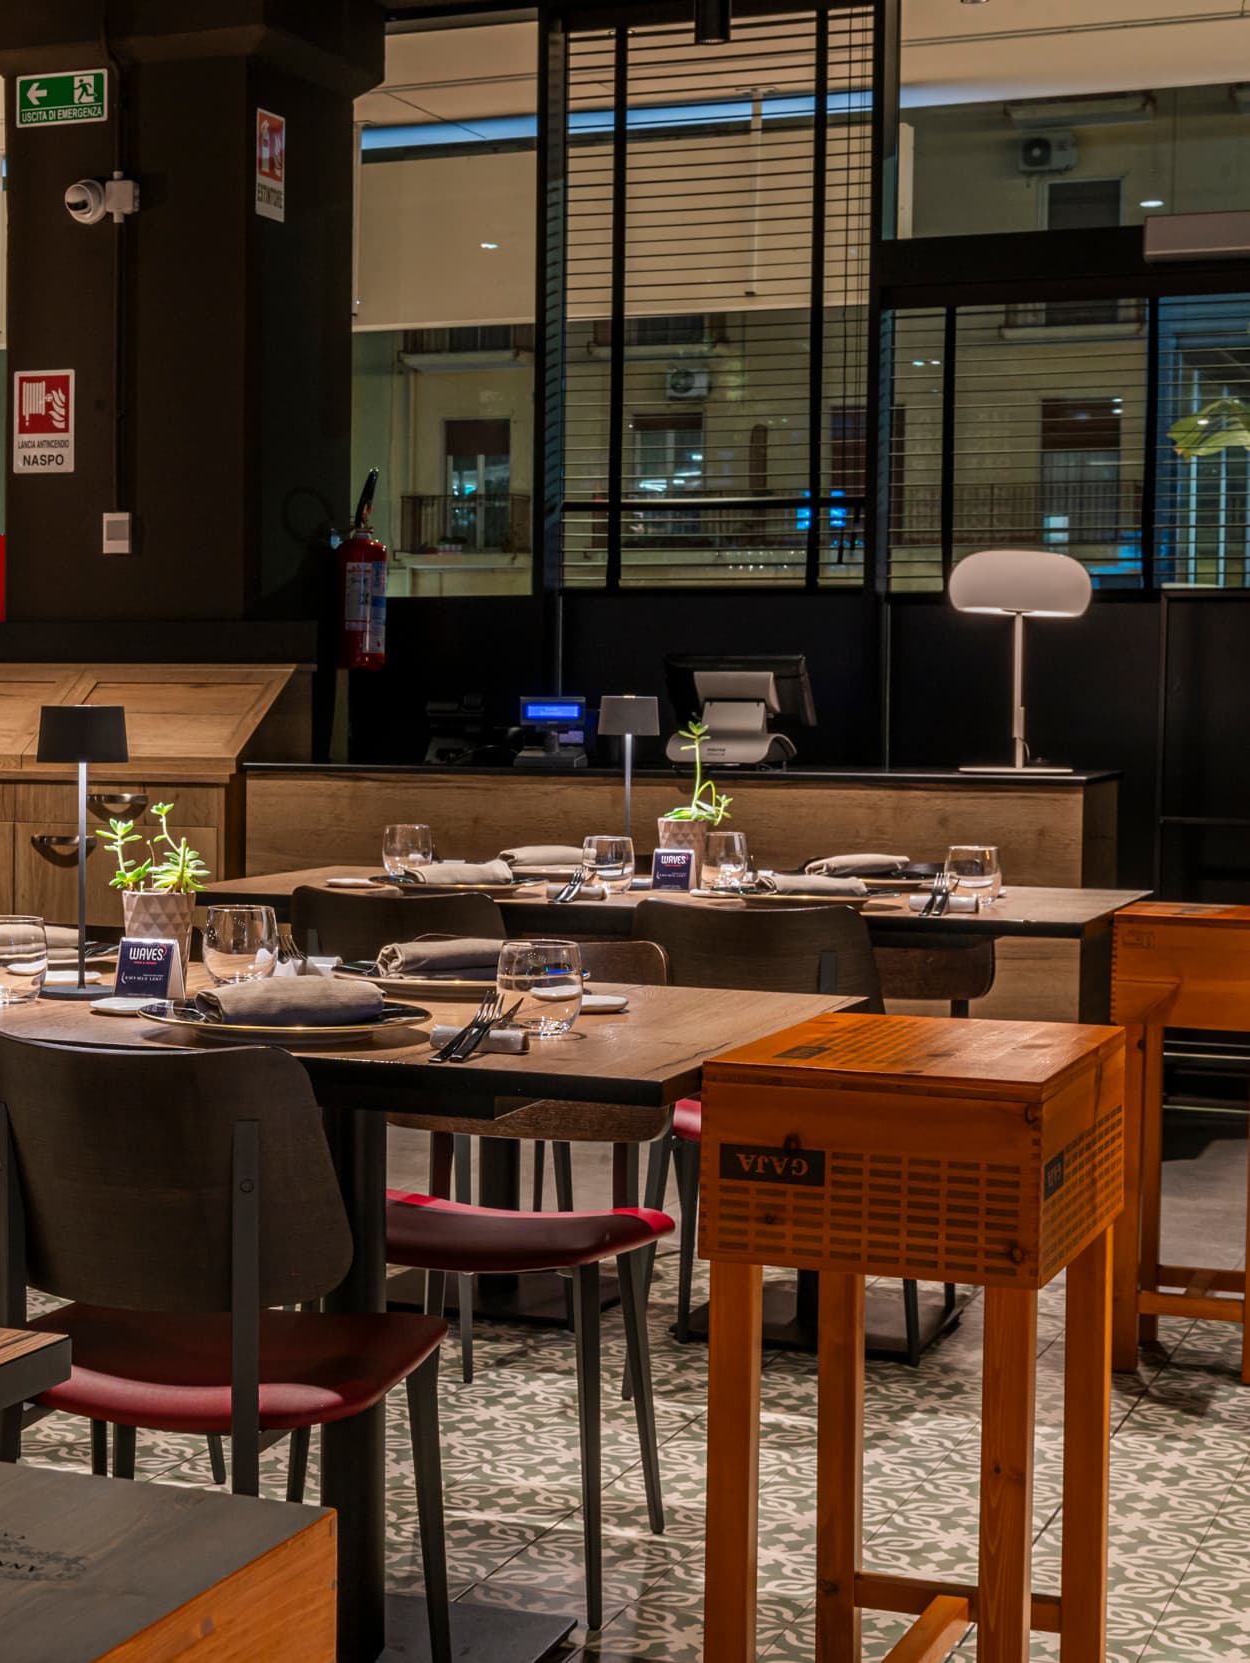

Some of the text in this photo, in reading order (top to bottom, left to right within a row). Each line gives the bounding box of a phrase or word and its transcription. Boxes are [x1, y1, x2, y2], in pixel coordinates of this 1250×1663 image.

[21, 106, 103, 123] USCITA DI EMERGENZA
[17, 439, 70, 449] LANCIA ANTINCENDIO
[22, 454, 65, 467] NASPO
[661, 855, 687, 865] WAVES
[129, 946, 164, 961] WAVES
[735, 1152, 809, 1177] GAJA
